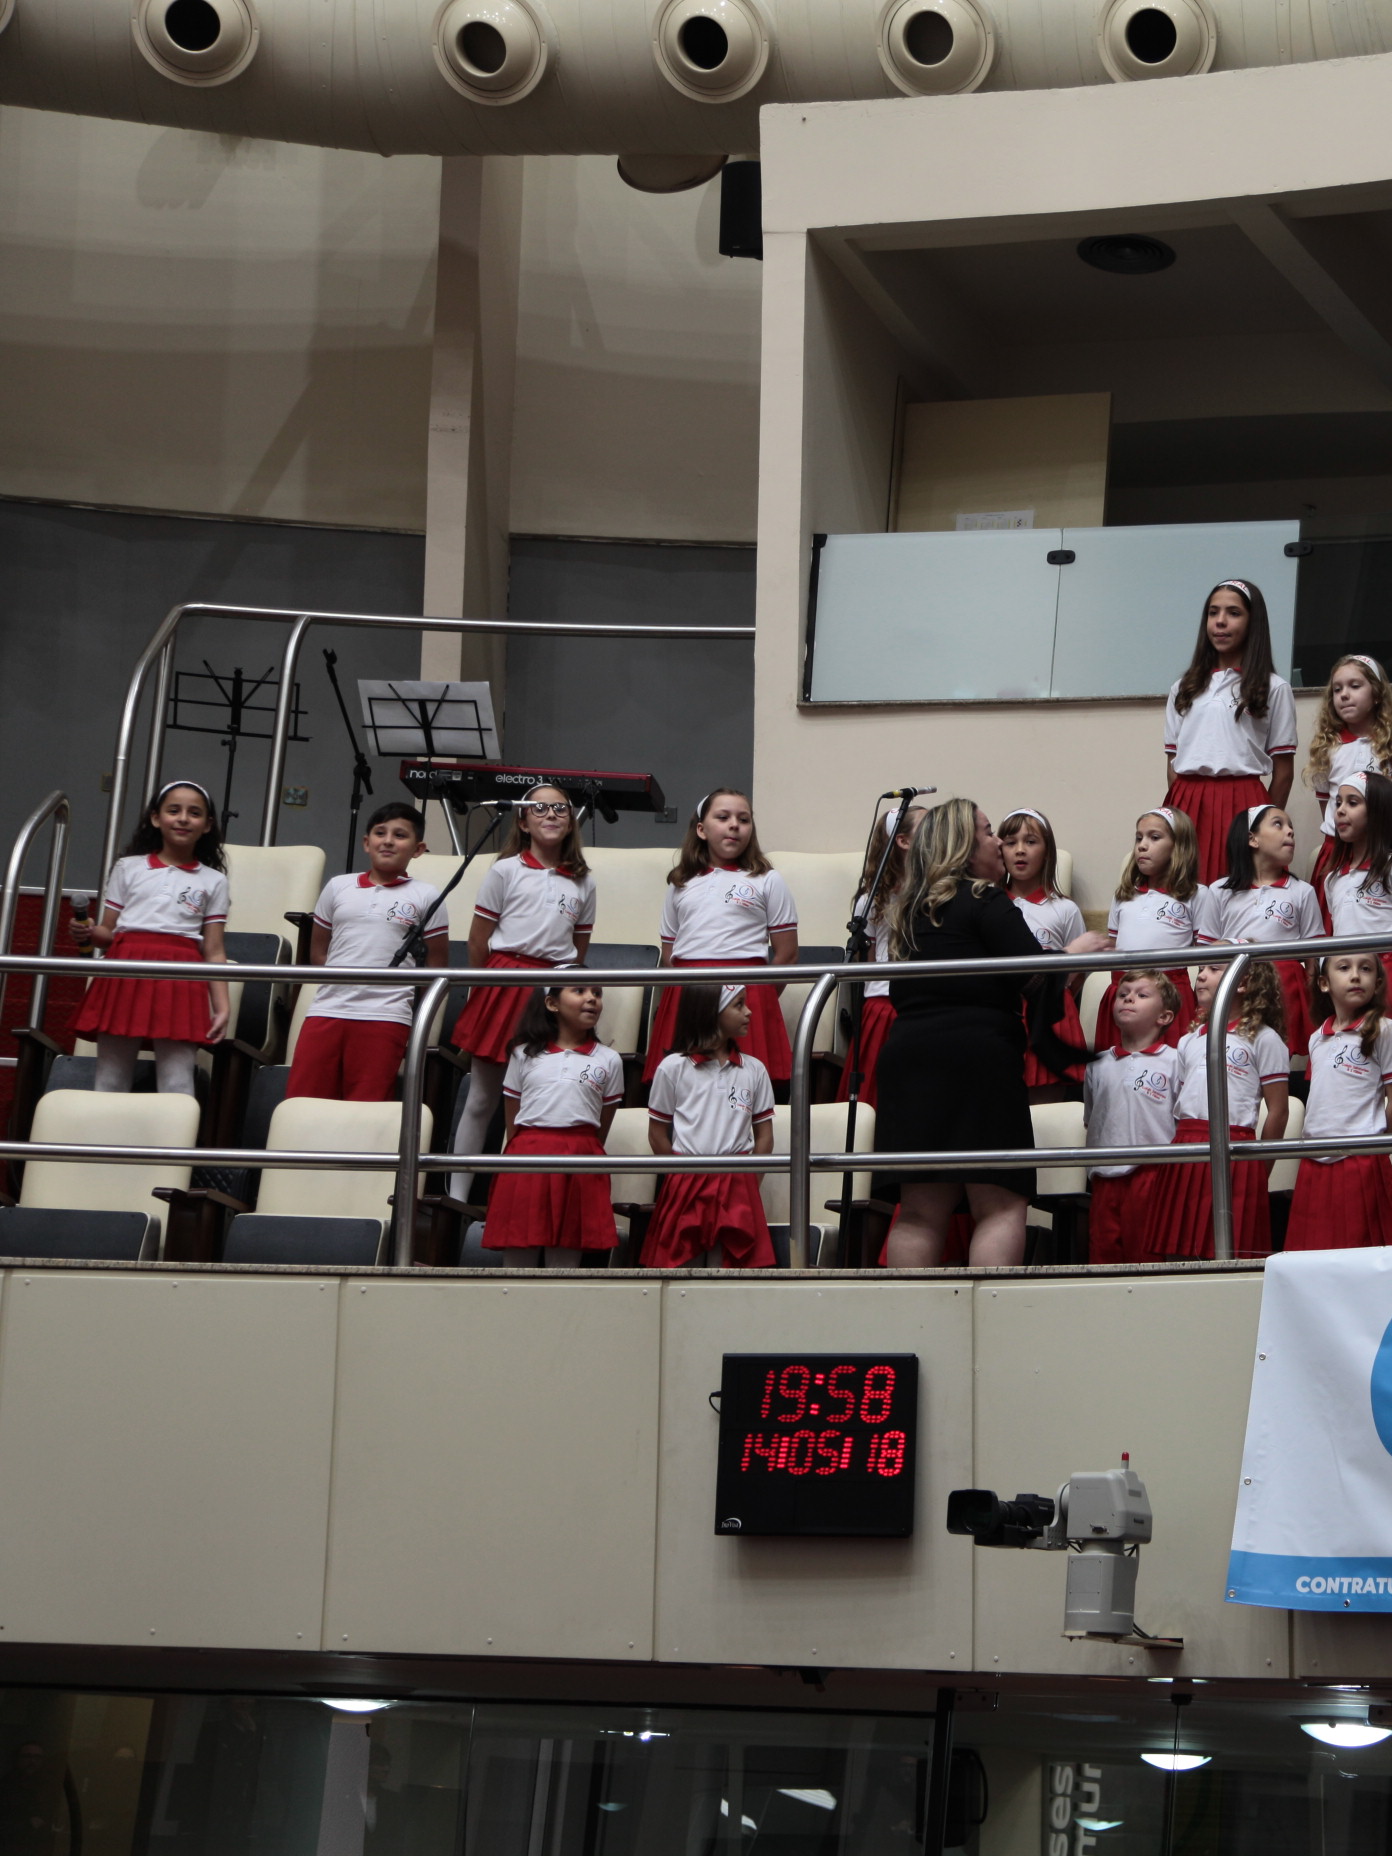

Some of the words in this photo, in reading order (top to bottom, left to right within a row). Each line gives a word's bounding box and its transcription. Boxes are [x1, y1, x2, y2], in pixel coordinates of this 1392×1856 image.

[495, 773, 536, 785] electro
[536, 775, 544, 785] 3
[759, 1364, 897, 1424] 19:58
